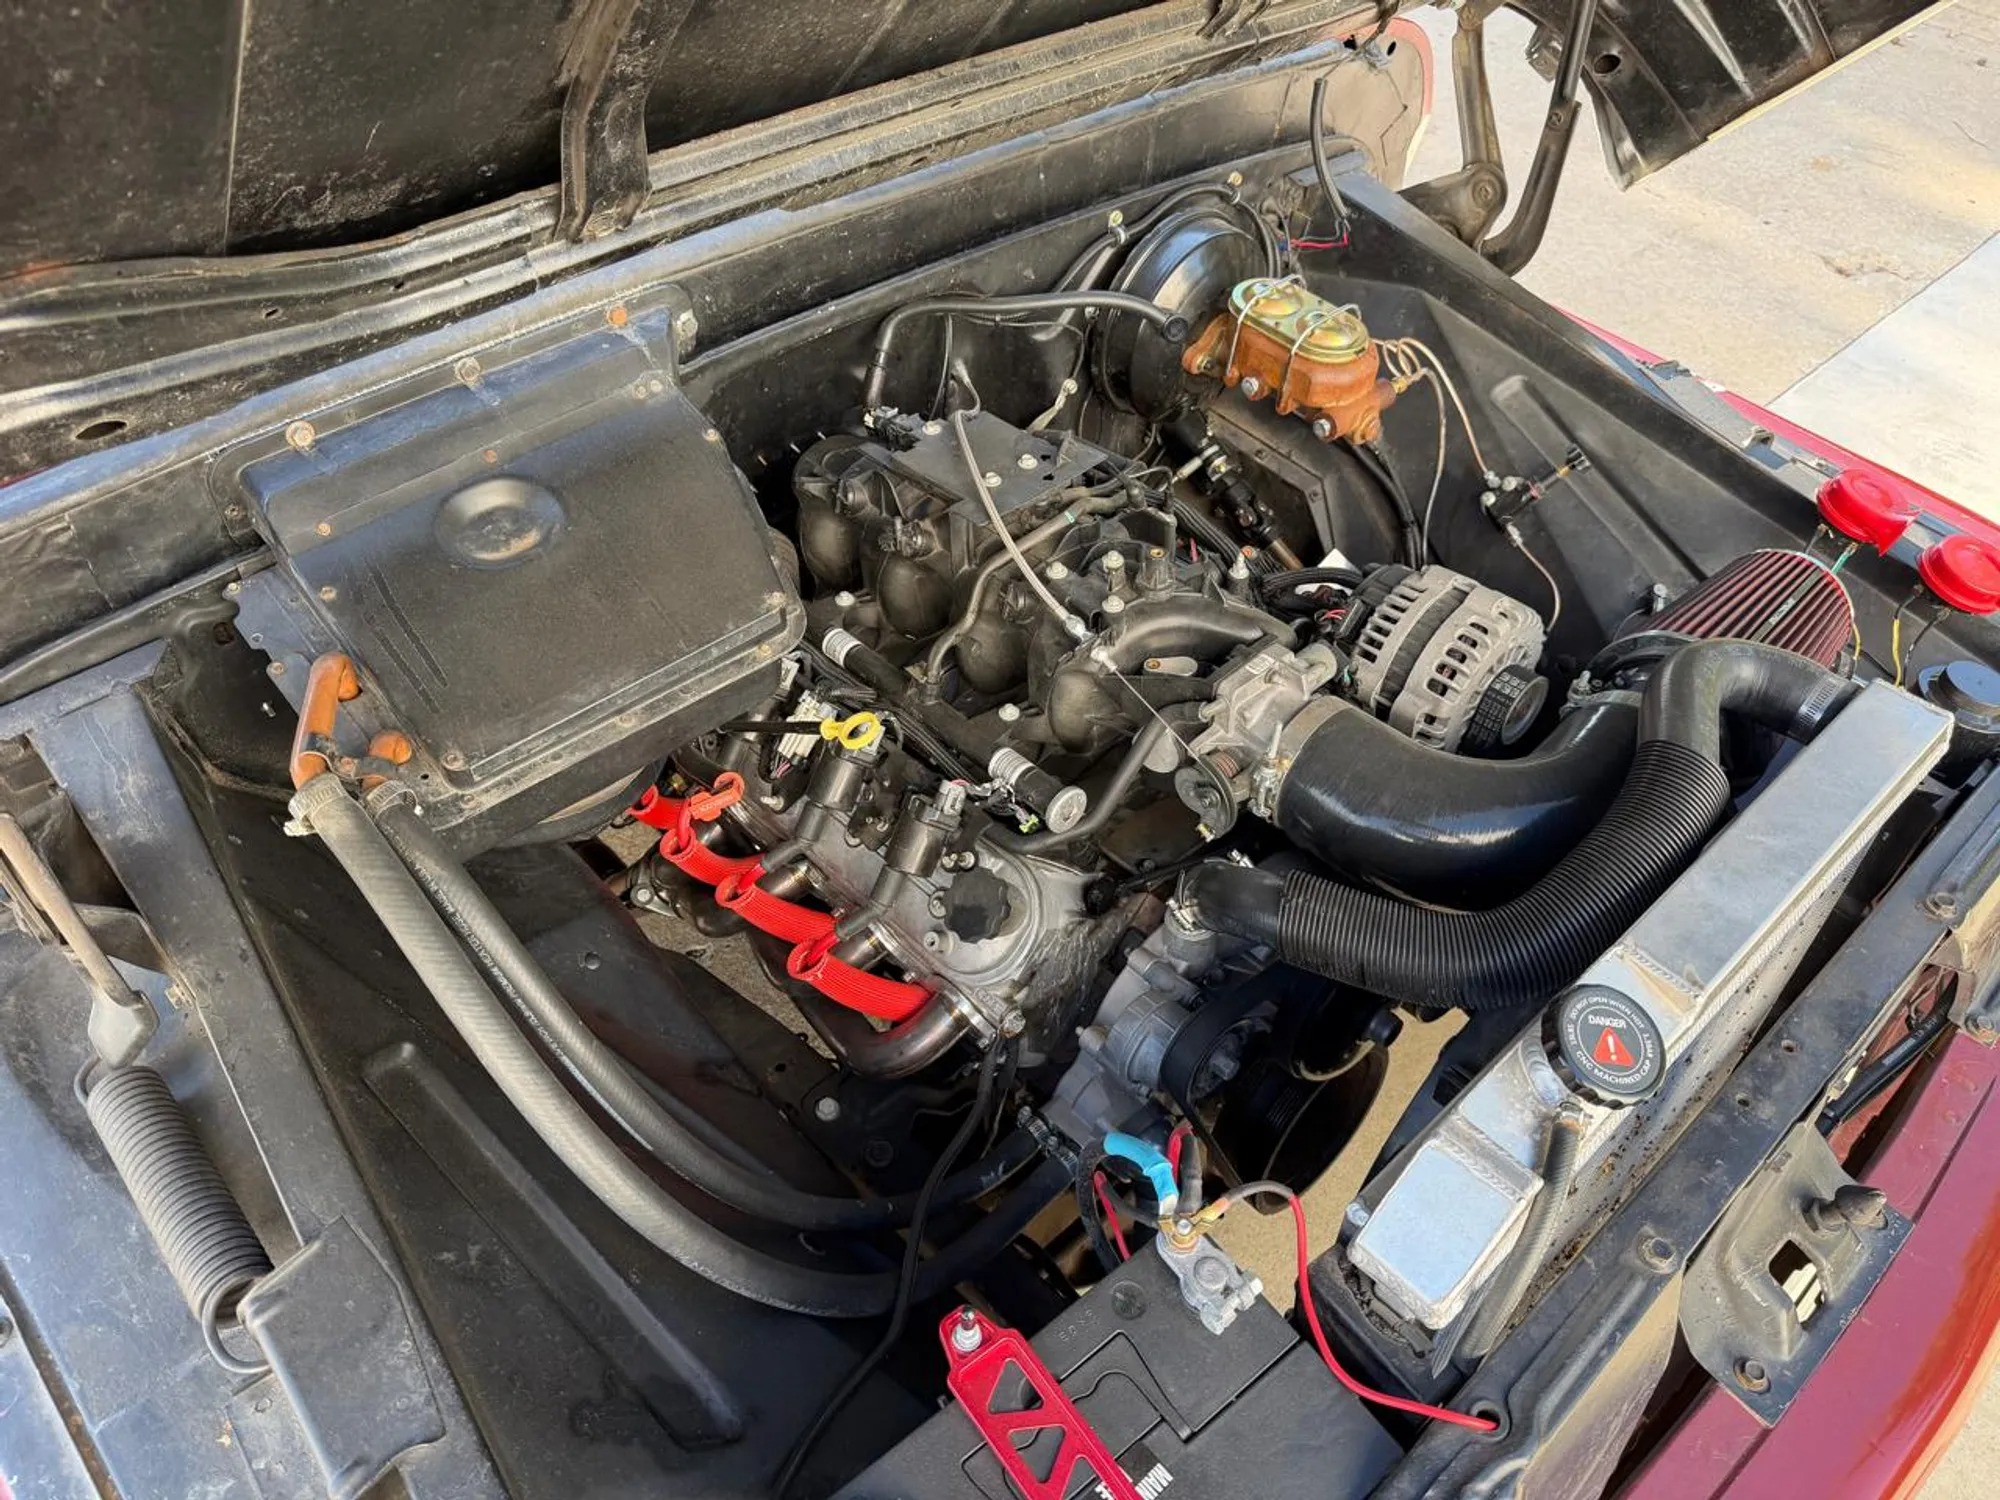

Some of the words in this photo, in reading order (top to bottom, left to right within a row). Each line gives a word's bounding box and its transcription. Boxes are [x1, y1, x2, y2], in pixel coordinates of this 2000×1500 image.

[1588, 1015, 1627, 1029] DANGER
[1609, 999, 1632, 1014] WHEN
[1631, 1013, 1645, 1028] HOT
[1576, 1050, 1594, 1070] CNC
[1594, 1068, 1642, 1084] MACHINED
[1640, 1059, 1651, 1076] CAP
